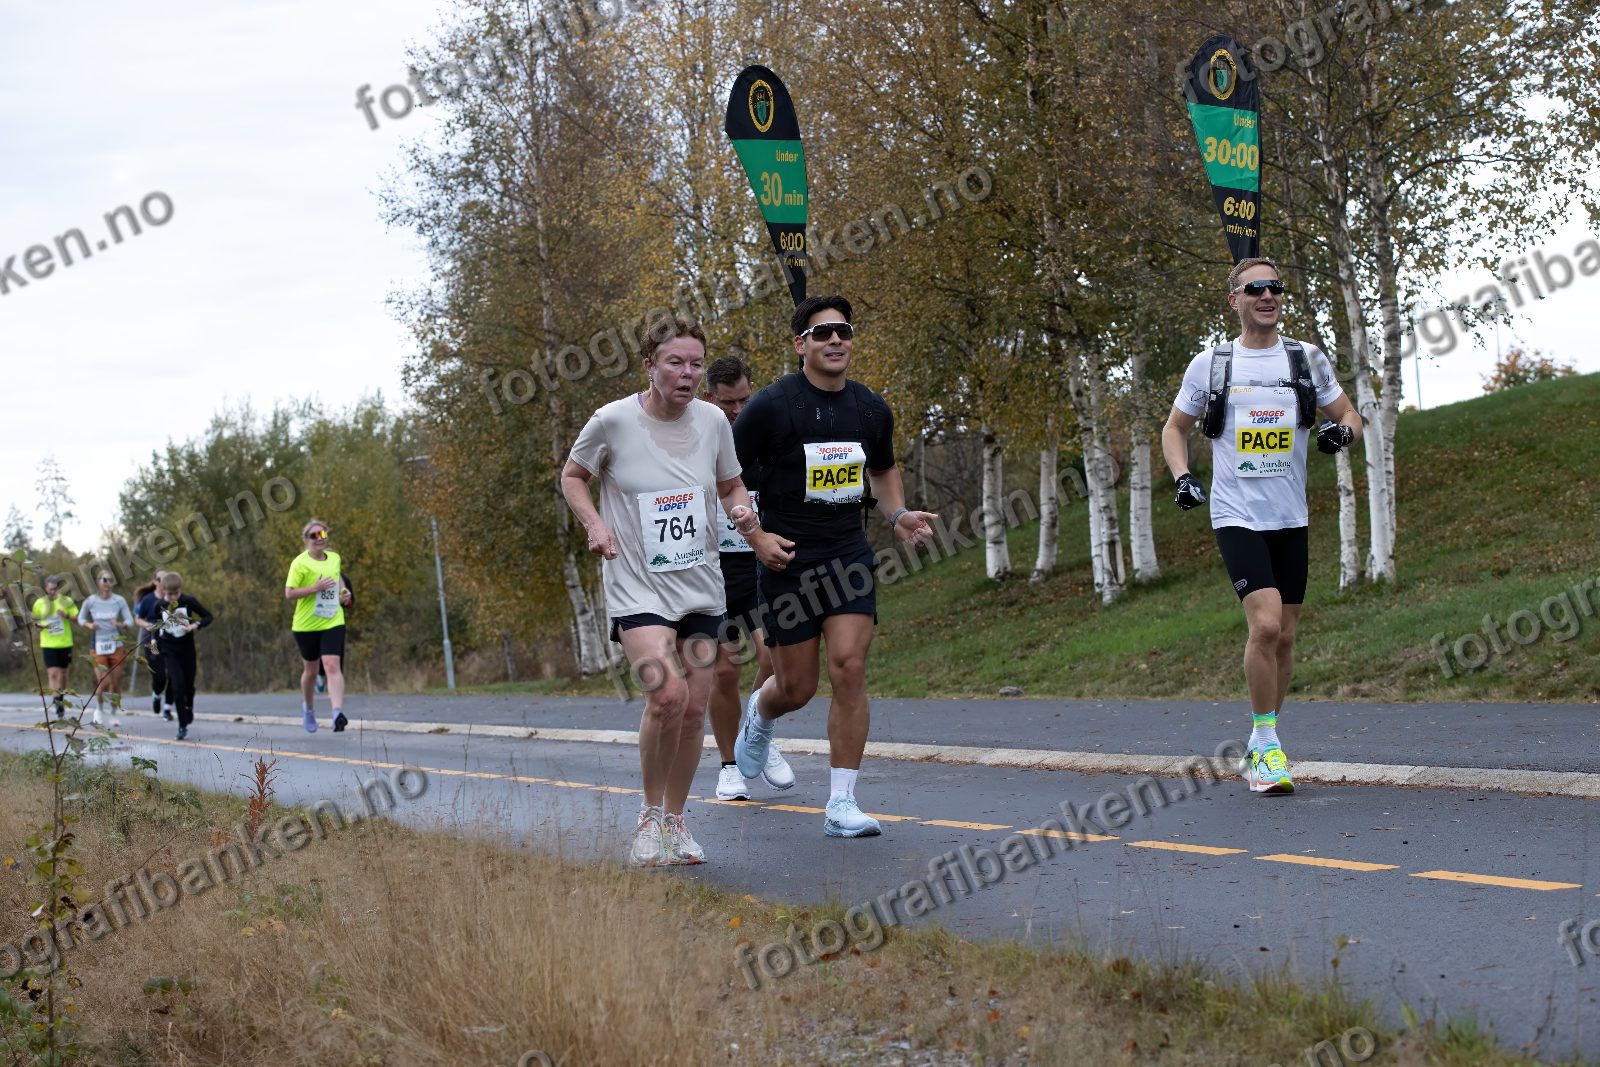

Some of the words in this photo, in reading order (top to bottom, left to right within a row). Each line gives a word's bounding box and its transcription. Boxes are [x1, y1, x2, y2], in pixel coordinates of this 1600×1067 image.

[1234, 112, 1256, 129] Under
[776, 150, 799, 162] Under
[1204, 136, 1260, 171] 30:00
[761, 171, 782, 207] 30
[784, 190, 804, 206] min
[1223, 196, 1256, 221] 6:00
[780, 231, 804, 251] 6:00
[1248, 410, 1286, 418] NORGES
[1241, 431, 1290, 450] PACE
[816, 446, 853, 455] NORGES
[822, 453, 849, 461] LØPET
[812, 465, 859, 488] PACE
[653, 493, 694, 506] NORGES
[658, 501, 689, 513] LØPET
[654, 515, 697, 543] 764
